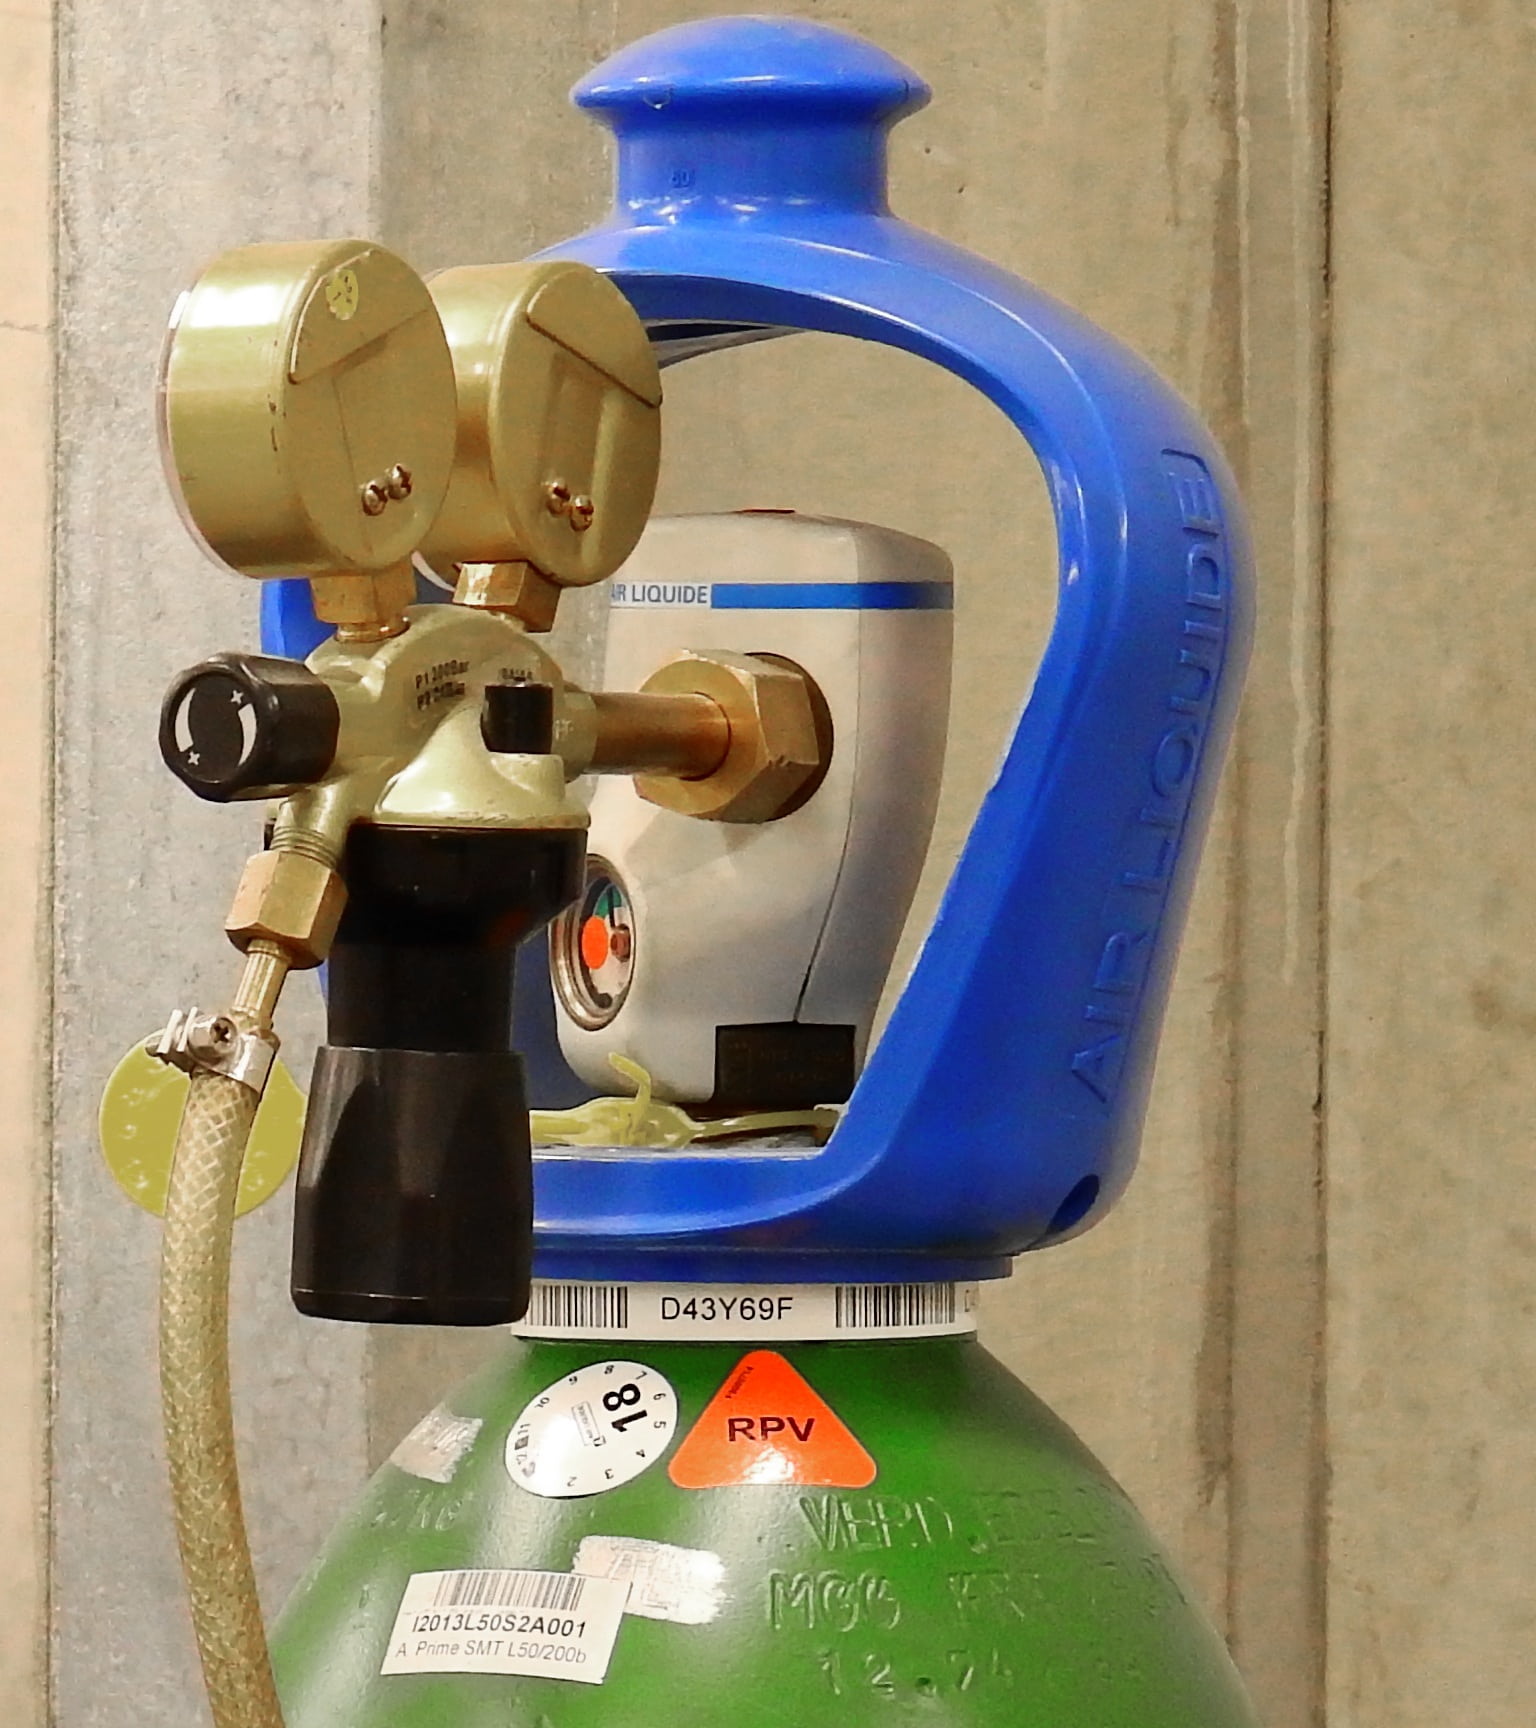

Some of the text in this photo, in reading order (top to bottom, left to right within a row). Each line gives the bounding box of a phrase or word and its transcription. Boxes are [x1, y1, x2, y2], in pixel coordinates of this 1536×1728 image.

[631, 584, 708, 604] LIQUIDE
[660, 1295, 795, 1323] D43Y69F
[602, 1383, 649, 1433] 18
[727, 1416, 816, 1443] RPV
[411, 1613, 587, 1639] I2013L50S2A001
[416, 1640, 461, 1658] Prime
[463, 1640, 504, 1659] SMT
[507, 1641, 587, 1665] L50/200b
